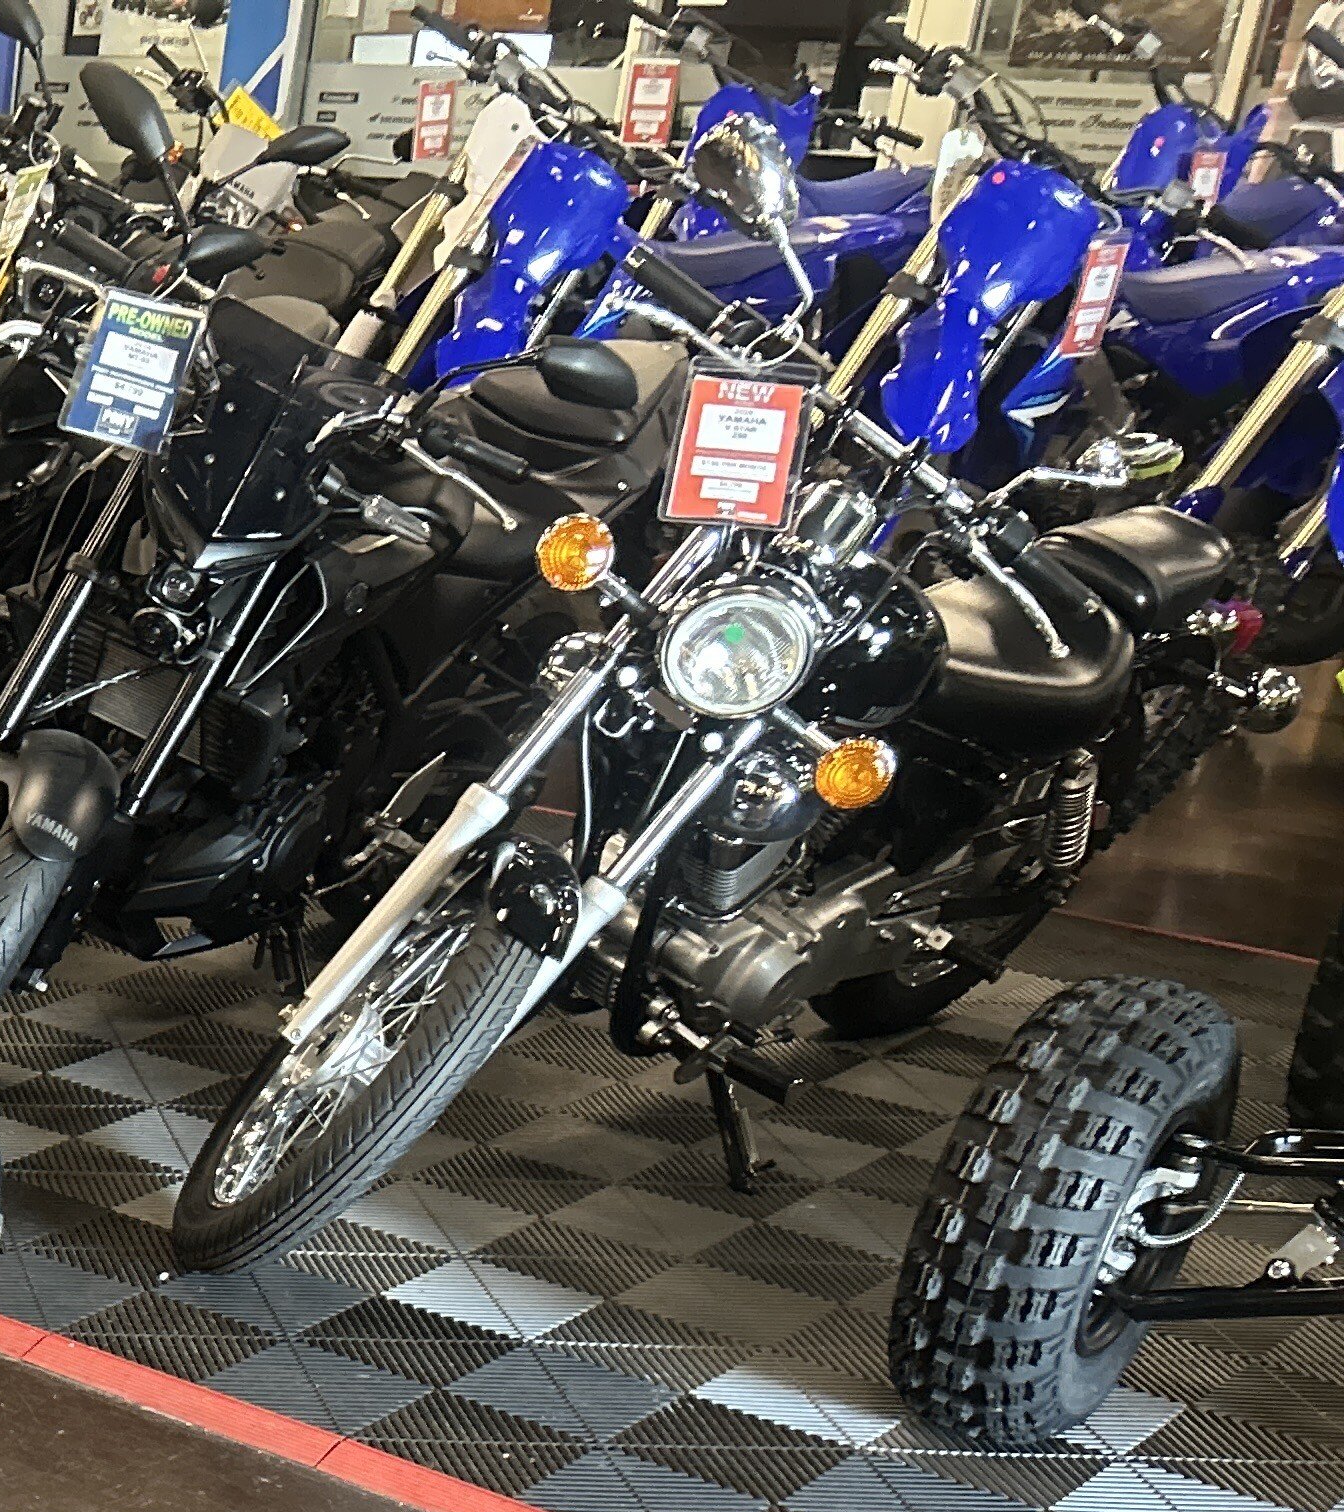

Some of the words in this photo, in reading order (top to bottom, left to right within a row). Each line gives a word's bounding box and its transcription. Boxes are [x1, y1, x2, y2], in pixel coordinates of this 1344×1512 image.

[227, 178, 255, 200] AMAHA
[108, 303, 193, 339] PRE-OWNED
[718, 381, 776, 403] NEW
[718, 415, 766, 426] YAMAHA
[24, 812, 79, 852] YAMAHA
